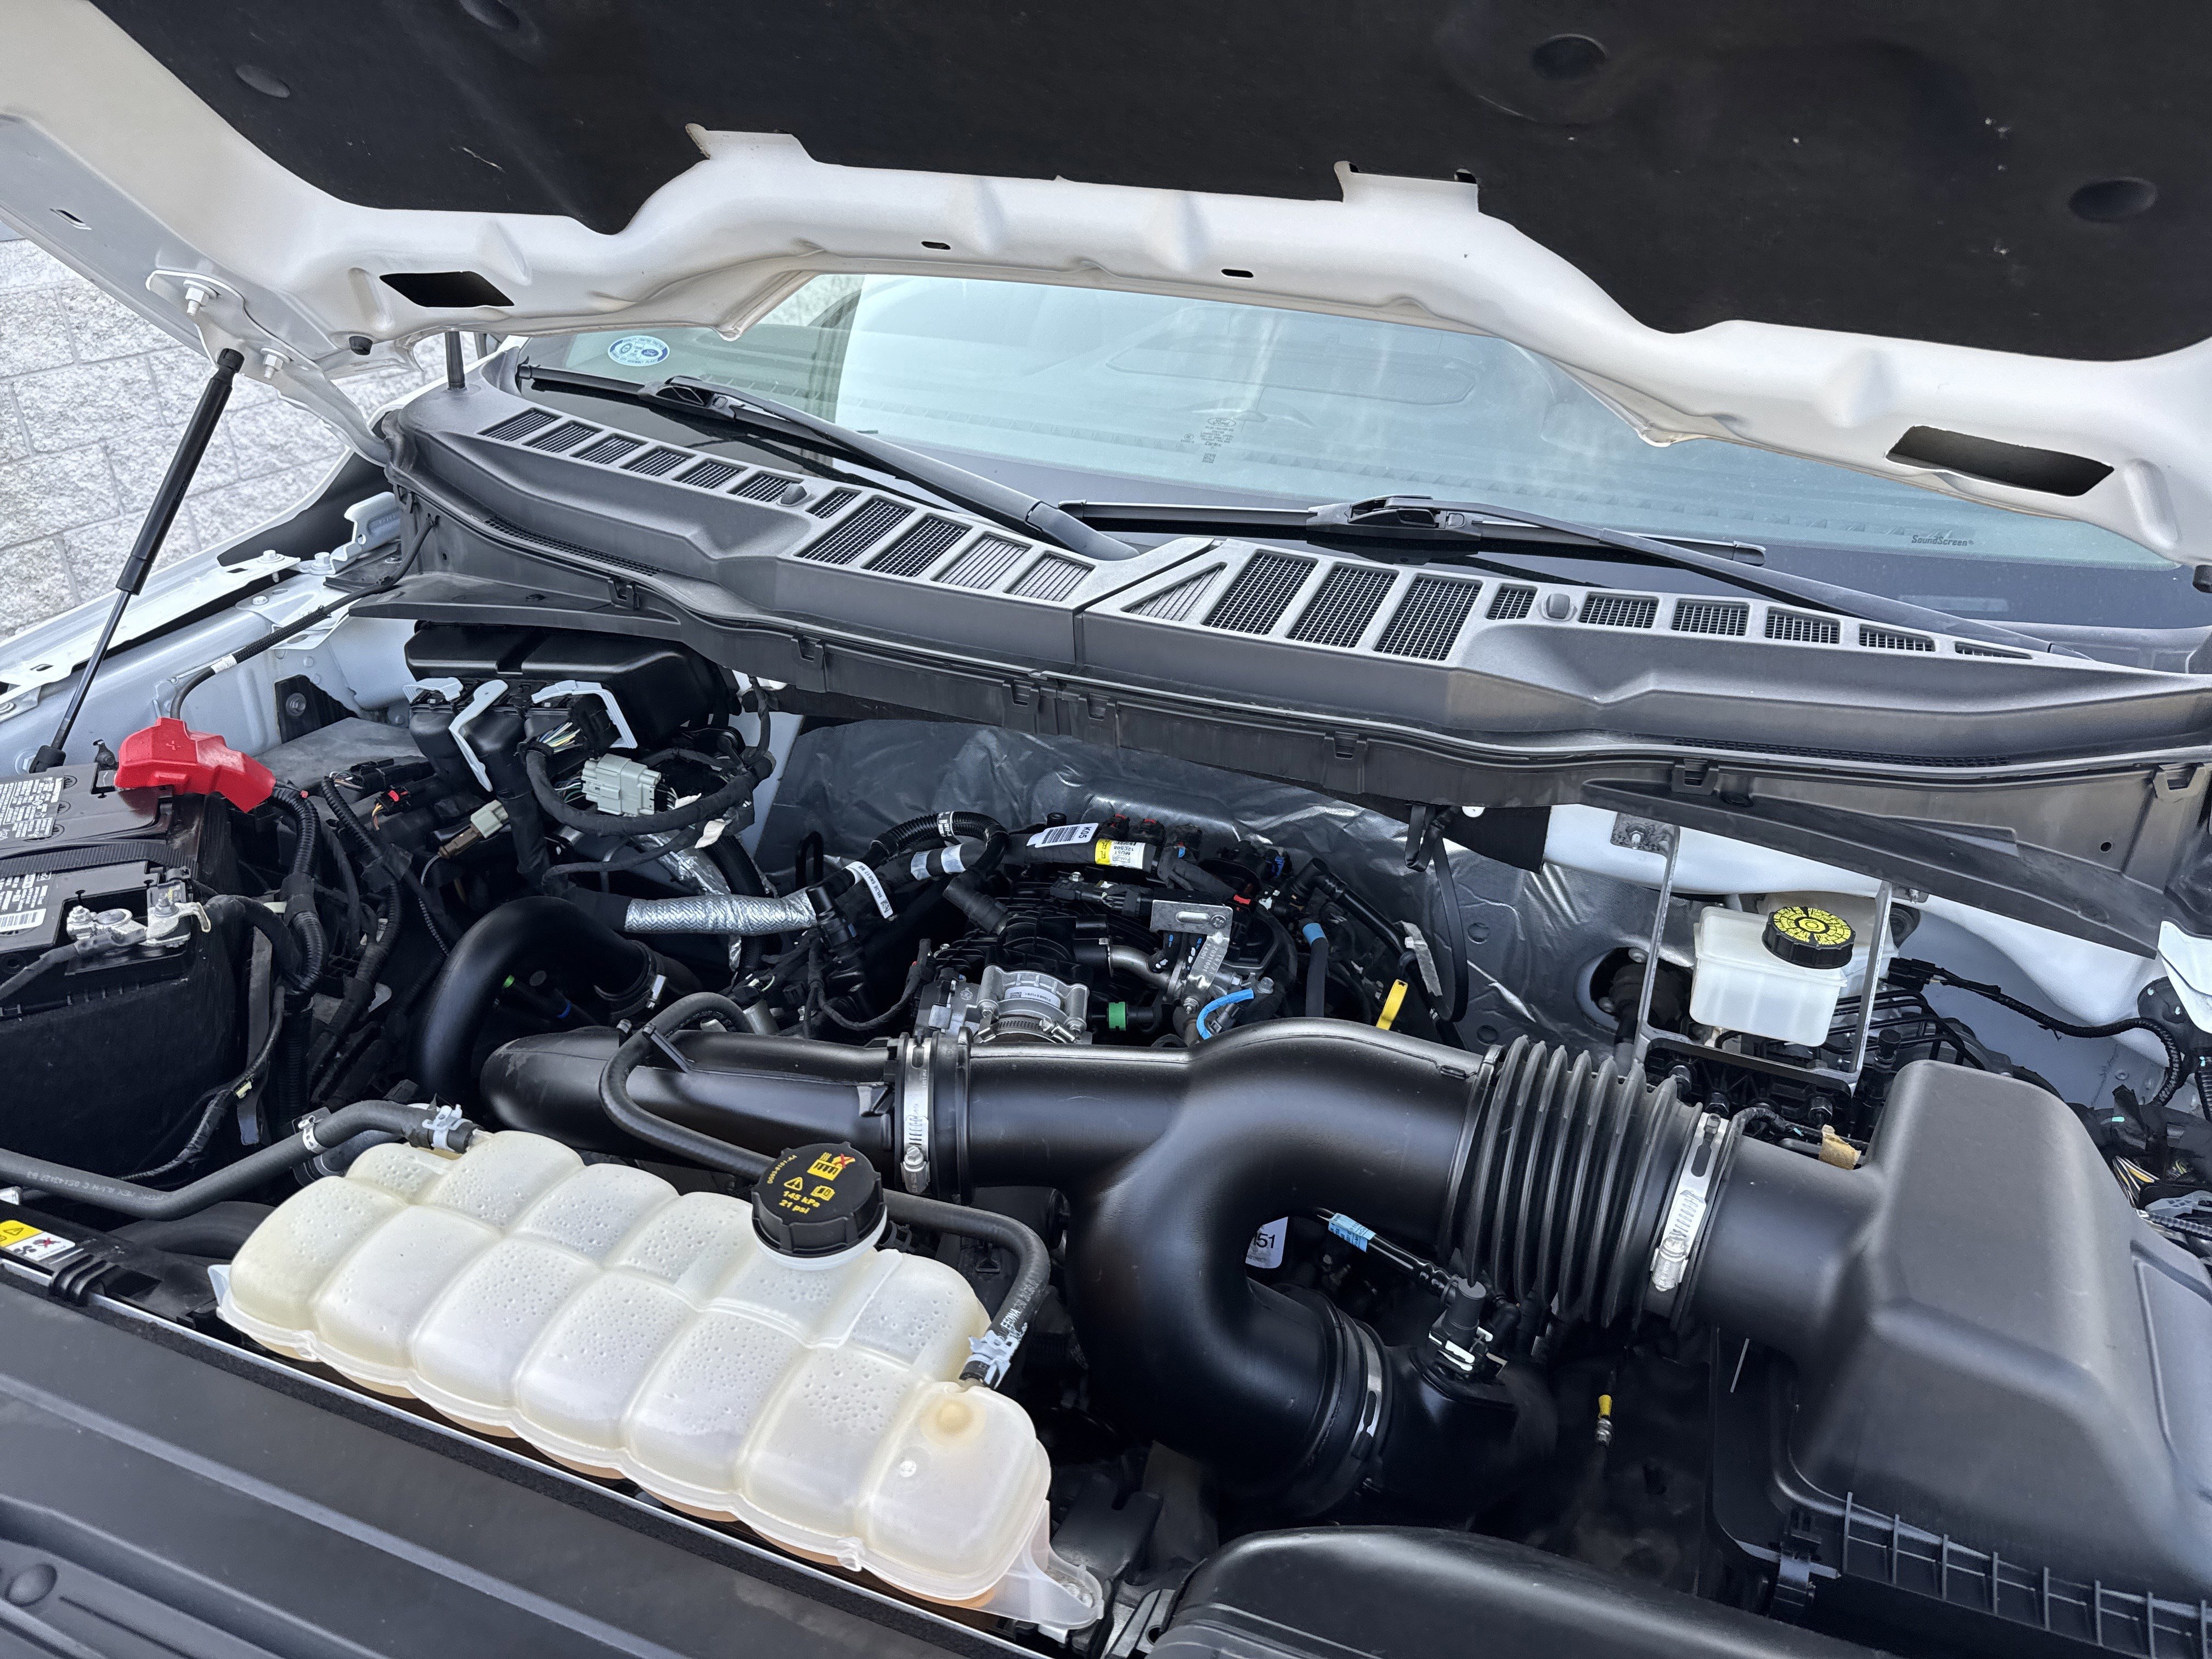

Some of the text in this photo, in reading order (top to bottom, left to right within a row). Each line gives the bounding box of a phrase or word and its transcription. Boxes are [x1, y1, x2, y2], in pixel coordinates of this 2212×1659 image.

[1079, 827, 1091, 838] K05
[778, 1199, 811, 1215] 21 psi
[783, 1190, 821, 1208] 145 kPa
